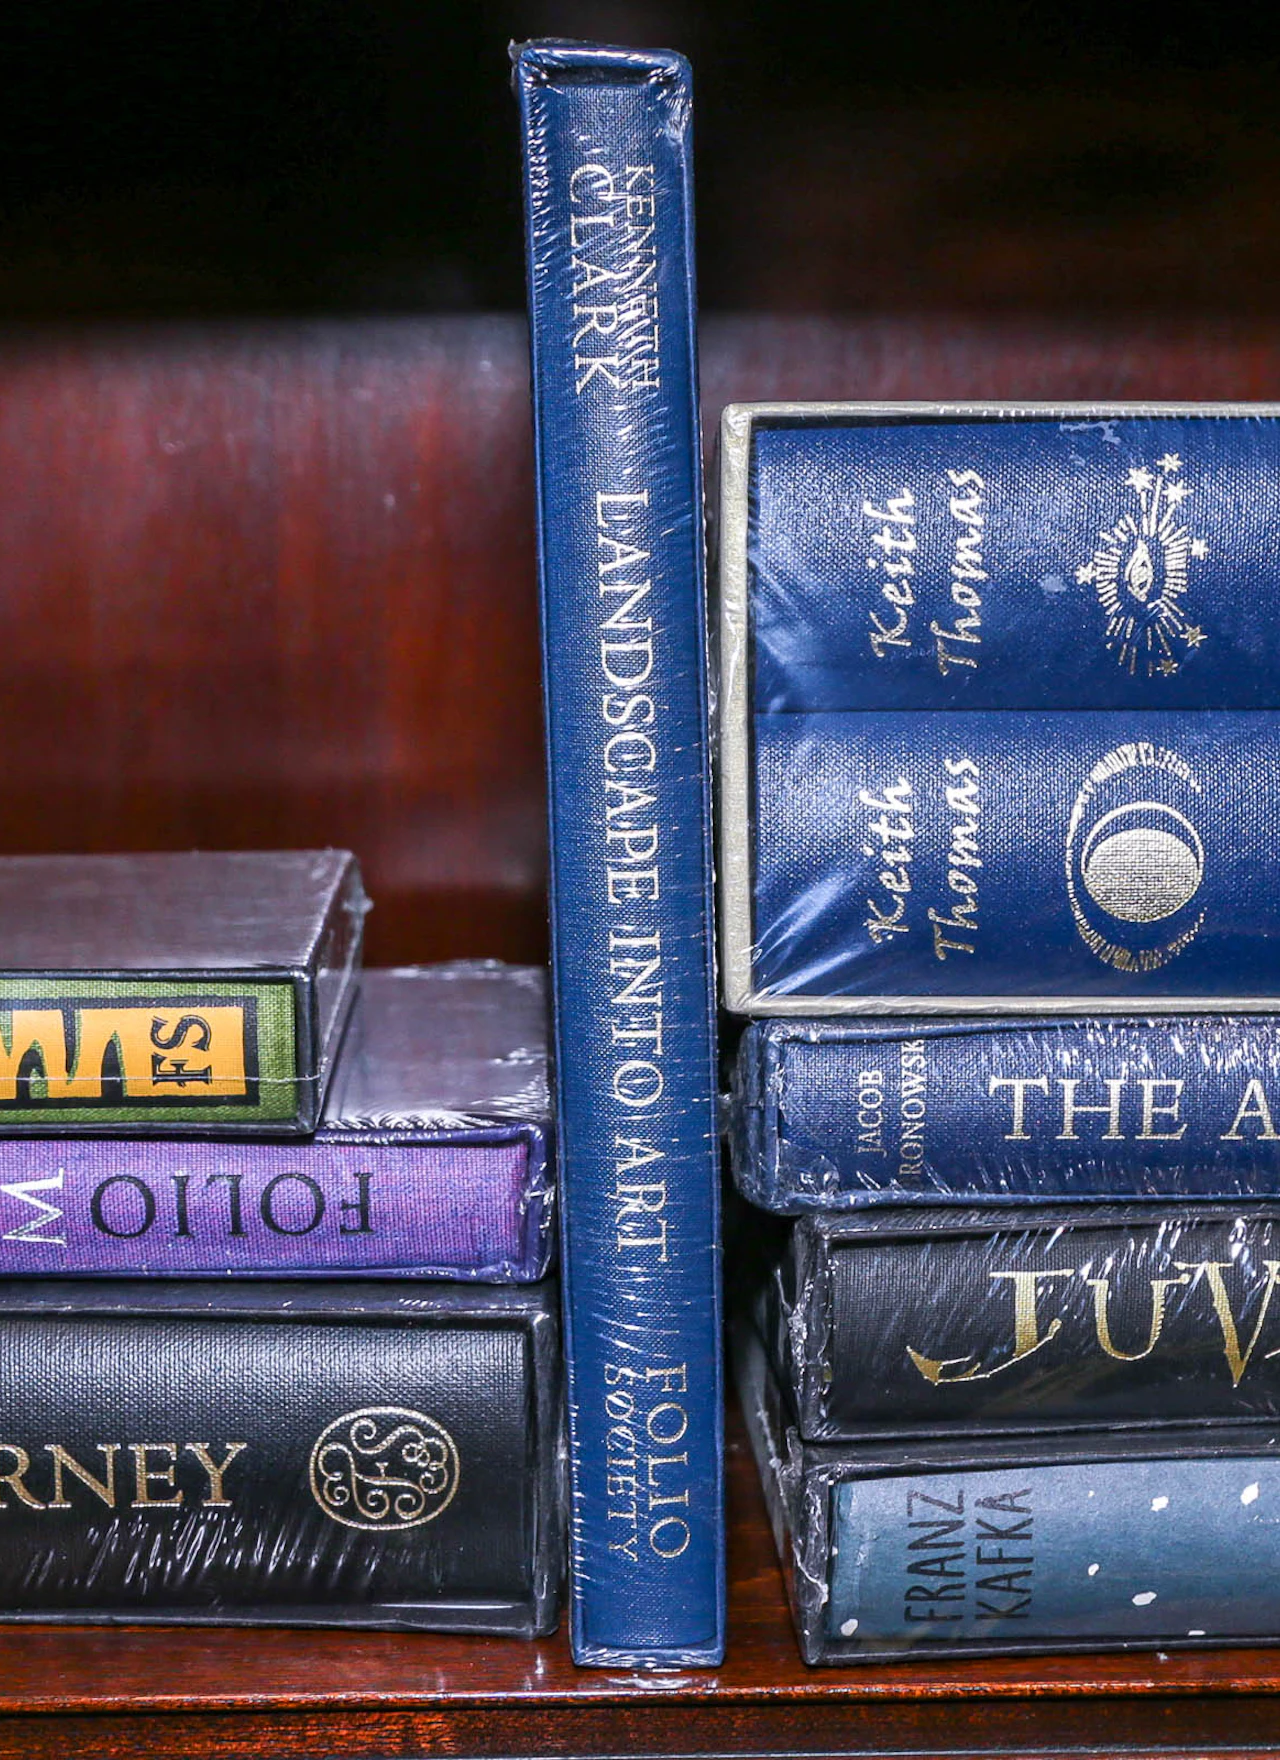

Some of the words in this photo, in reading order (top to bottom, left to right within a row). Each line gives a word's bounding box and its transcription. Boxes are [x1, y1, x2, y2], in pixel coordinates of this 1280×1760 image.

[569, 163, 623, 396] CLARK
[624, 163, 660, 388] KENNETH
[862, 486, 917, 658] Keith
[929, 468, 989, 677] Thomas
[595, 488, 661, 905] LANDSCAPE
[858, 775, 915, 944] Keith
[927, 757, 984, 961] Thomas
[151, 1011, 214, 1088] FS
[607, 931, 665, 1108] INTO
[855, 1069, 888, 1158] JACOB
[988, 1075, 1190, 1142] THE
[89, 1171, 376, 1240] FOLIO
[615, 1136, 669, 1263] ART
[603, 1363, 639, 1562] SOCIETY
[644, 1361, 690, 1559] FOLIO
[903, 1487, 966, 1624] FRANZ
[974, 1487, 1035, 1622] KAFKA
